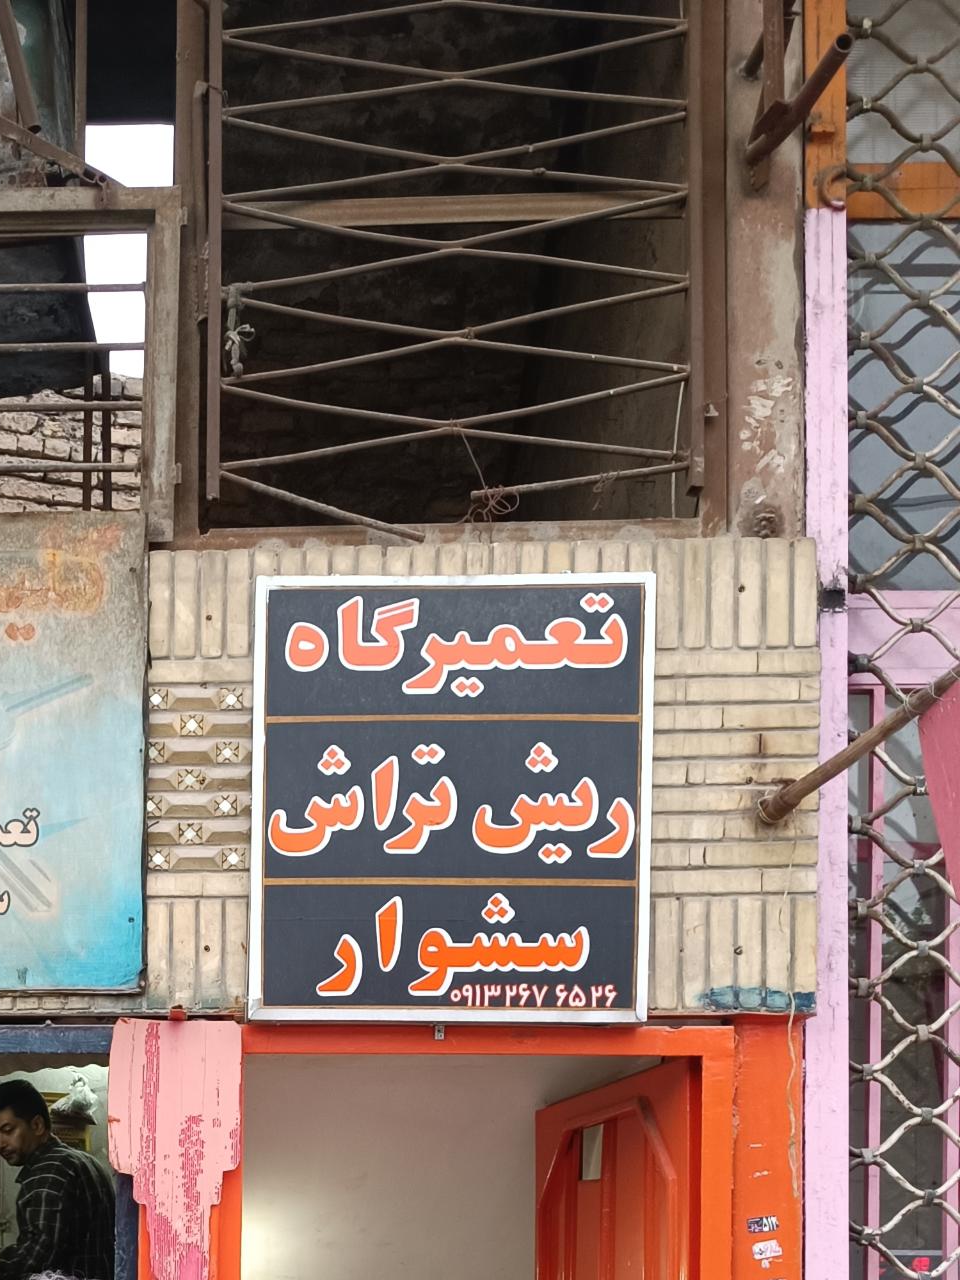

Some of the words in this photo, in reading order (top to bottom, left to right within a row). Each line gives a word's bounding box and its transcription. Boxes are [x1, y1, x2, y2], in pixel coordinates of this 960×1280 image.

[285, 592, 629, 698] تعمیرگاه
[268, 743, 459, 857] تراش
[472, 741, 637, 865] ریش
